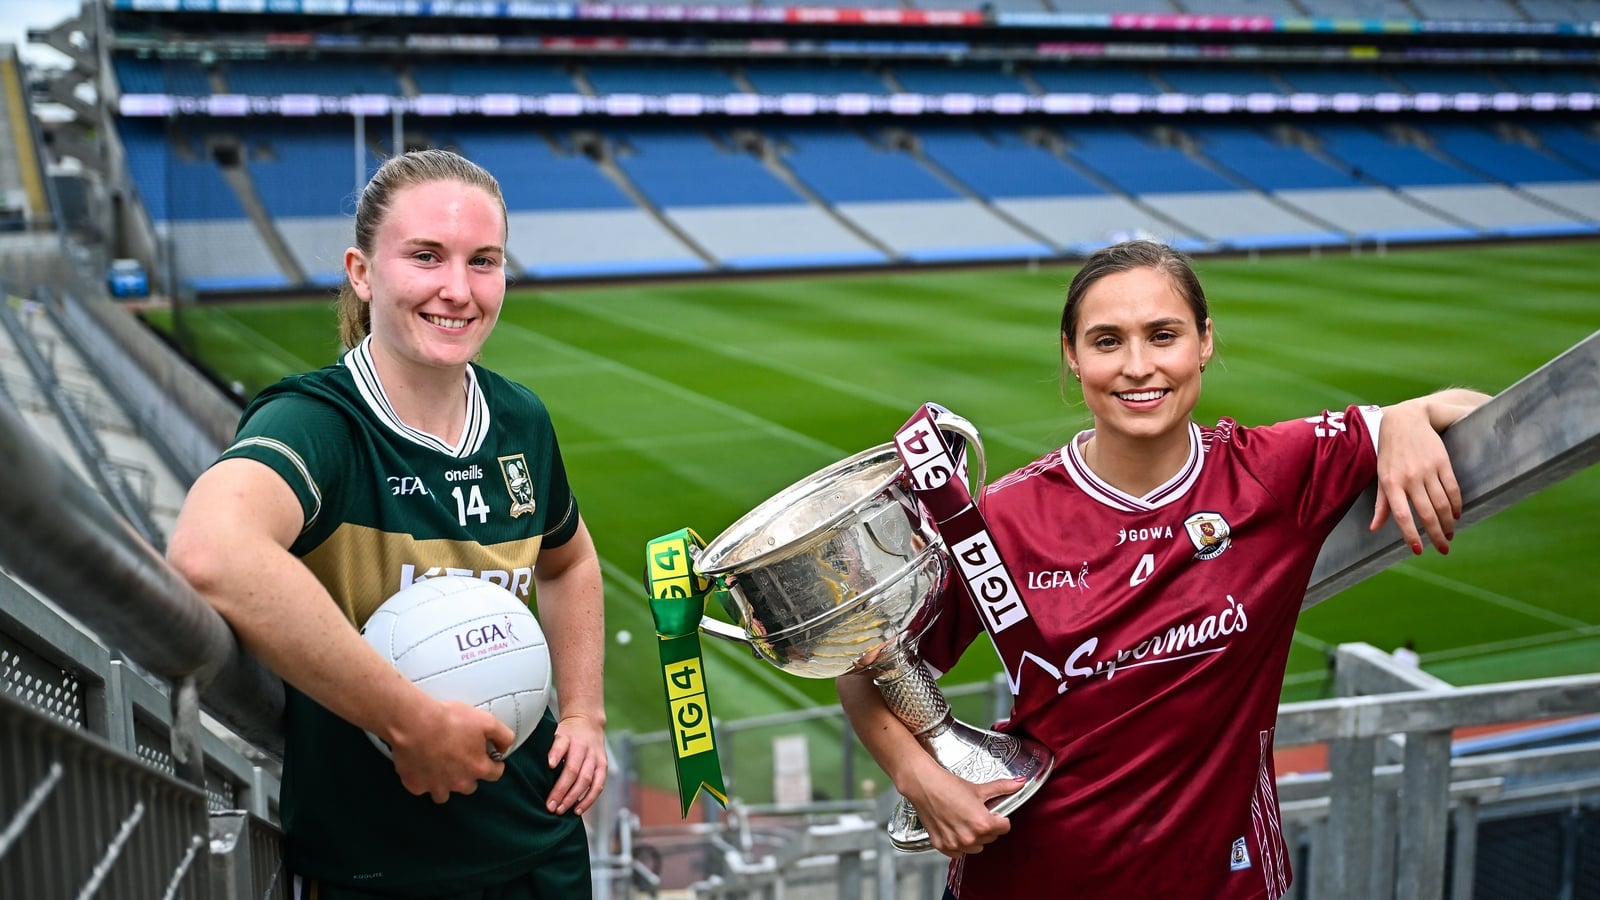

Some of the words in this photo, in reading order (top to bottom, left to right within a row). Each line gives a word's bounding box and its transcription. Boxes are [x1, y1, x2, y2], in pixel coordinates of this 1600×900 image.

[903, 429, 952, 490] G4
[386, 476, 429, 496] GFA
[451, 484, 491, 528] 14
[1128, 526, 1174, 542] GOWA
[400, 563, 535, 597] KRR
[654, 546, 687, 600] G4
[960, 541, 1018, 626] TG4
[1028, 570, 1077, 590] LGFA
[1129, 553, 1155, 588] 4
[455, 623, 507, 652] LGFA
[670, 665, 707, 751] TG4
